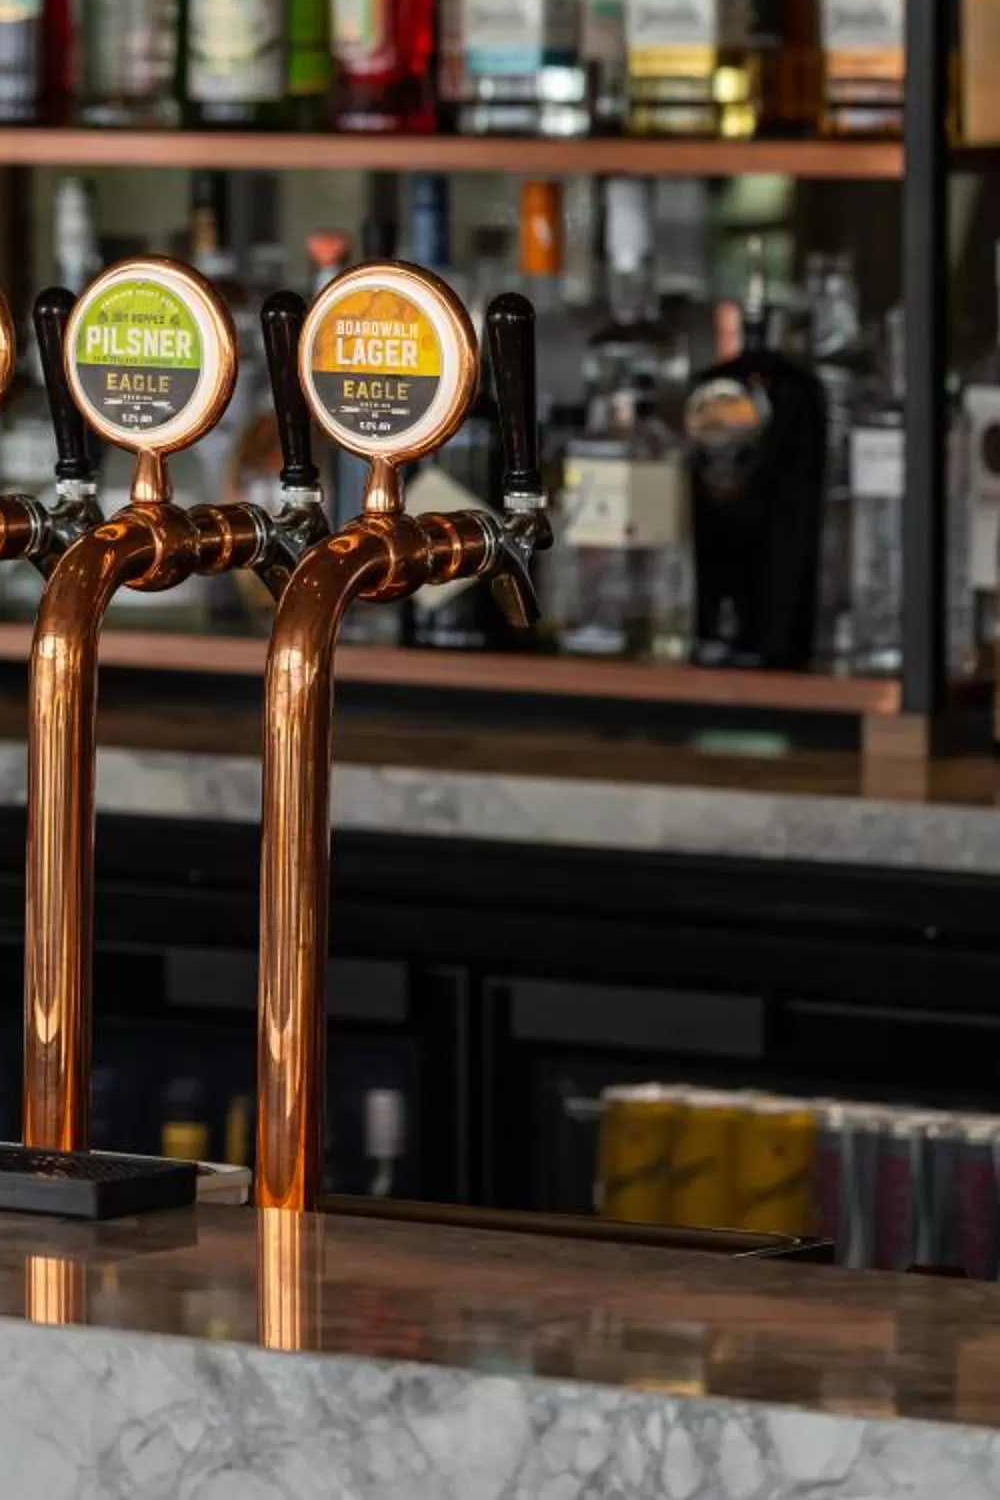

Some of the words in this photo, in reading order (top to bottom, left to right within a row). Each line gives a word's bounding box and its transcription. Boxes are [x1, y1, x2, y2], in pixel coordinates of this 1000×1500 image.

[86, 325, 192, 359] PILSNER
[336, 337, 418, 368] LAGER
[106, 373, 170, 393] EAGLE
[343, 379, 410, 400] EAGLE
